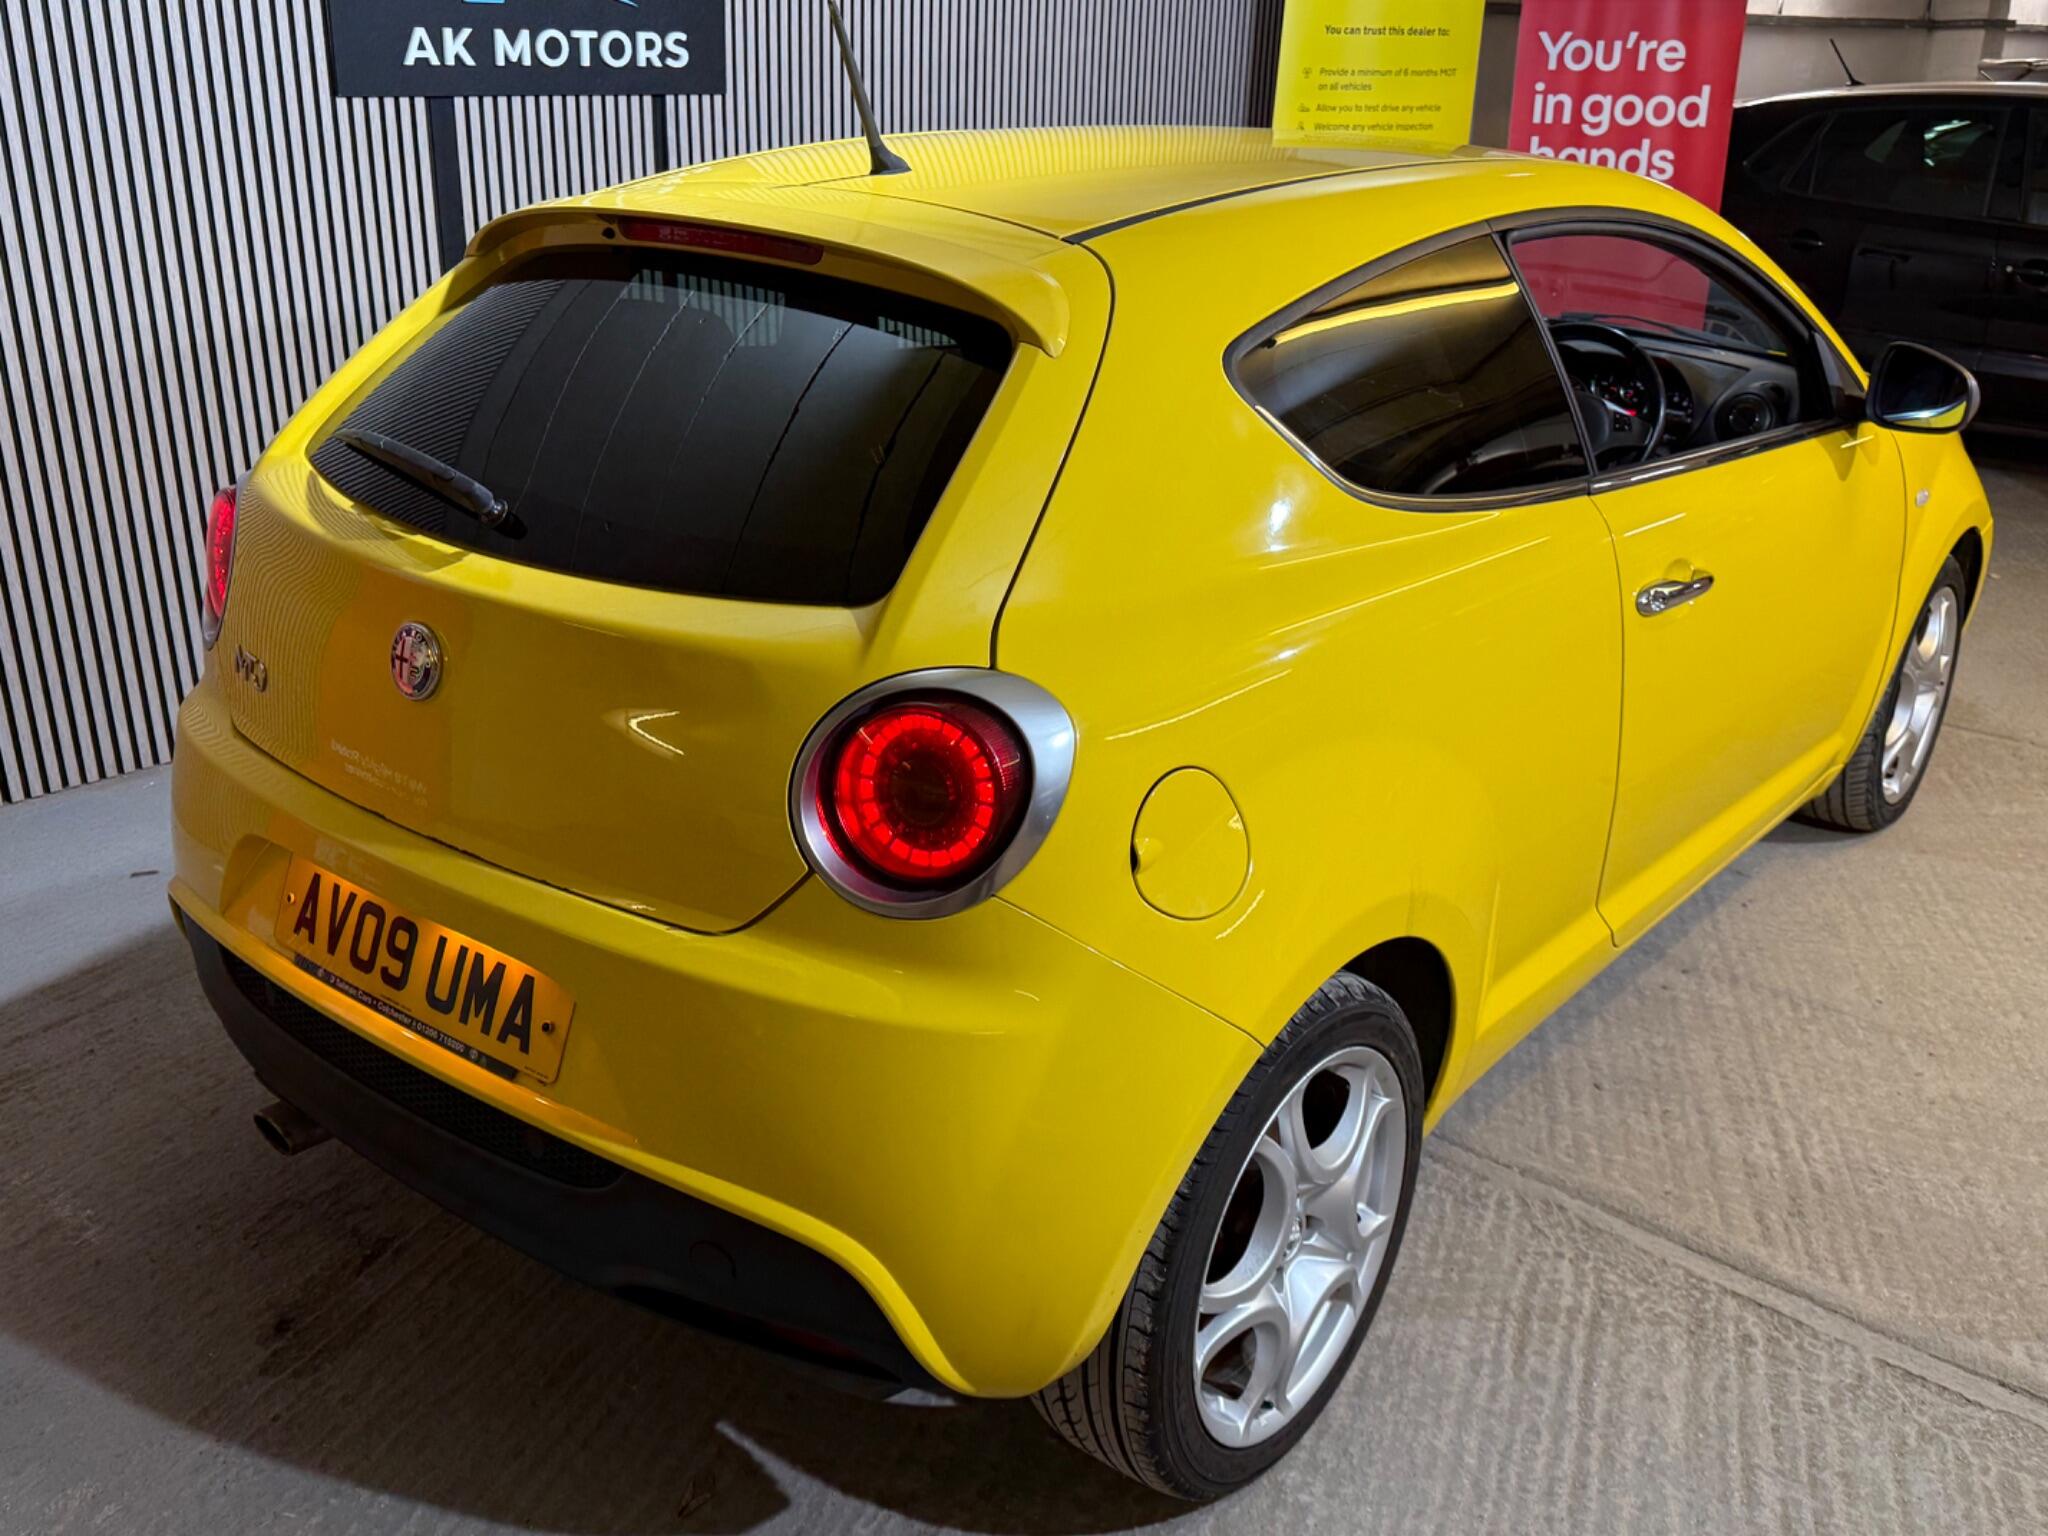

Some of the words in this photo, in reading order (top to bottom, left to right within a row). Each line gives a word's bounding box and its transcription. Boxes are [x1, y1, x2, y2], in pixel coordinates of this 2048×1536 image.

[1325, 25, 1342, 35] You
[1344, 27, 1361, 35] can
[1363, 26, 1387, 36] trust
[1389, 26, 1405, 36] this
[1407, 26, 1436, 37] dealer
[1438, 27, 1450, 37] to:
[402, 27, 477, 67] AK
[492, 28, 690, 69] MOTORS
[1319, 67, 1349, 76] Provide
[1357, 68, 1392, 76] minimum
[1410, 68, 1438, 77] months
[1440, 67, 1457, 77] MOT
[1329, 82, 1339, 91] all
[1340, 82, 1372, 91] vehicles
[1316, 104, 1336, 112] Allow
[1338, 105, 1352, 114] you
[1354, 104, 1362, 112] to
[1364, 104, 1379, 112] test
[1381, 104, 1399, 112] drive
[1401, 105, 1413, 114] any
[1415, 104, 1441, 112] vehicle
[1532, 81, 1573, 124] in
[1581, 84, 1711, 136] good
[1313, 122, 1350, 131] Welcome
[1351, 124, 1365, 132] any
[1367, 122, 1393, 131] vehicle
[1395, 123, 1433, 132] inspection
[293, 872, 419, 992] AV09
[425, 934, 535, 1055] UMA
